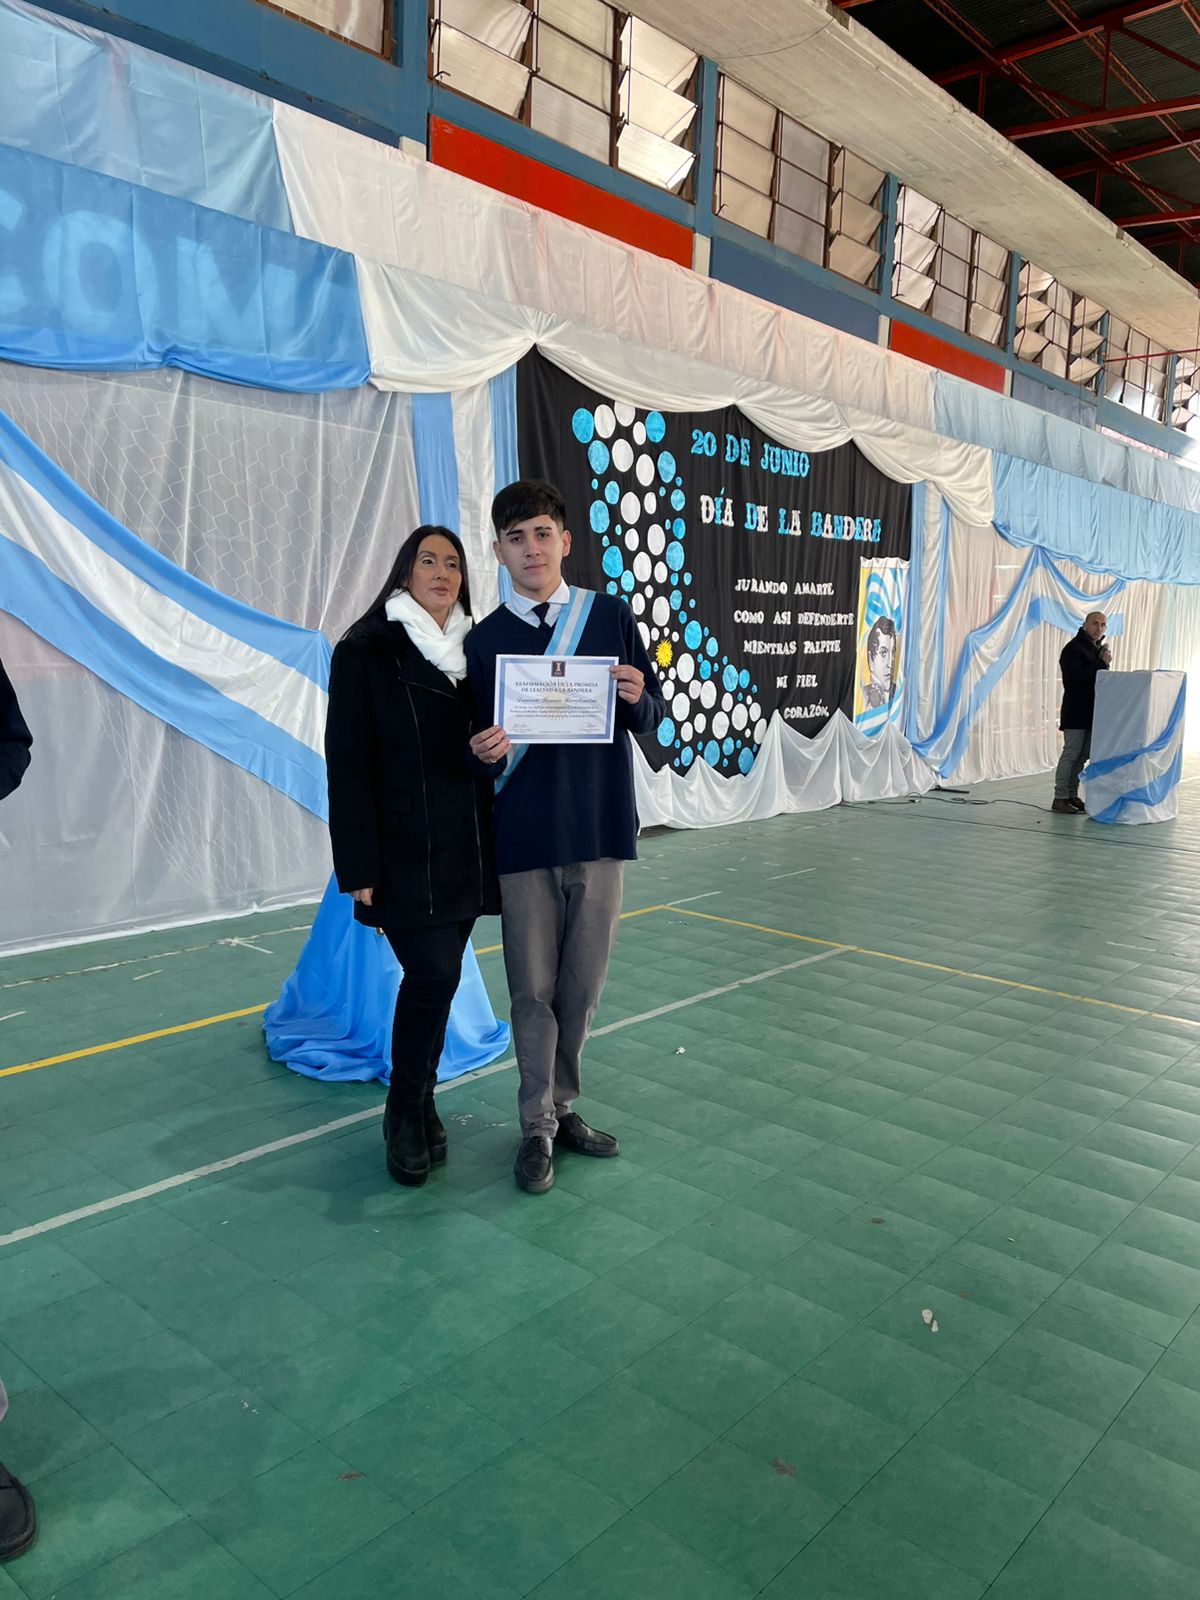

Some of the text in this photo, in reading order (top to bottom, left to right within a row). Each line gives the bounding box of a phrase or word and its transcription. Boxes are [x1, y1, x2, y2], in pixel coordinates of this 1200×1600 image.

[0, 188, 297, 352] OM
[690, 428, 810, 478] 20 DE JUNIO
[700, 486, 882, 543] DÍA DE LA BANDERA
[734, 578, 835, 596] JURANDO AMARTE
[733, 609, 855, 626] COMO ASI DEFENDERTE
[743, 640, 841, 655] MIENTRAS PALPITE
[796, 675, 818, 688] FIEL
